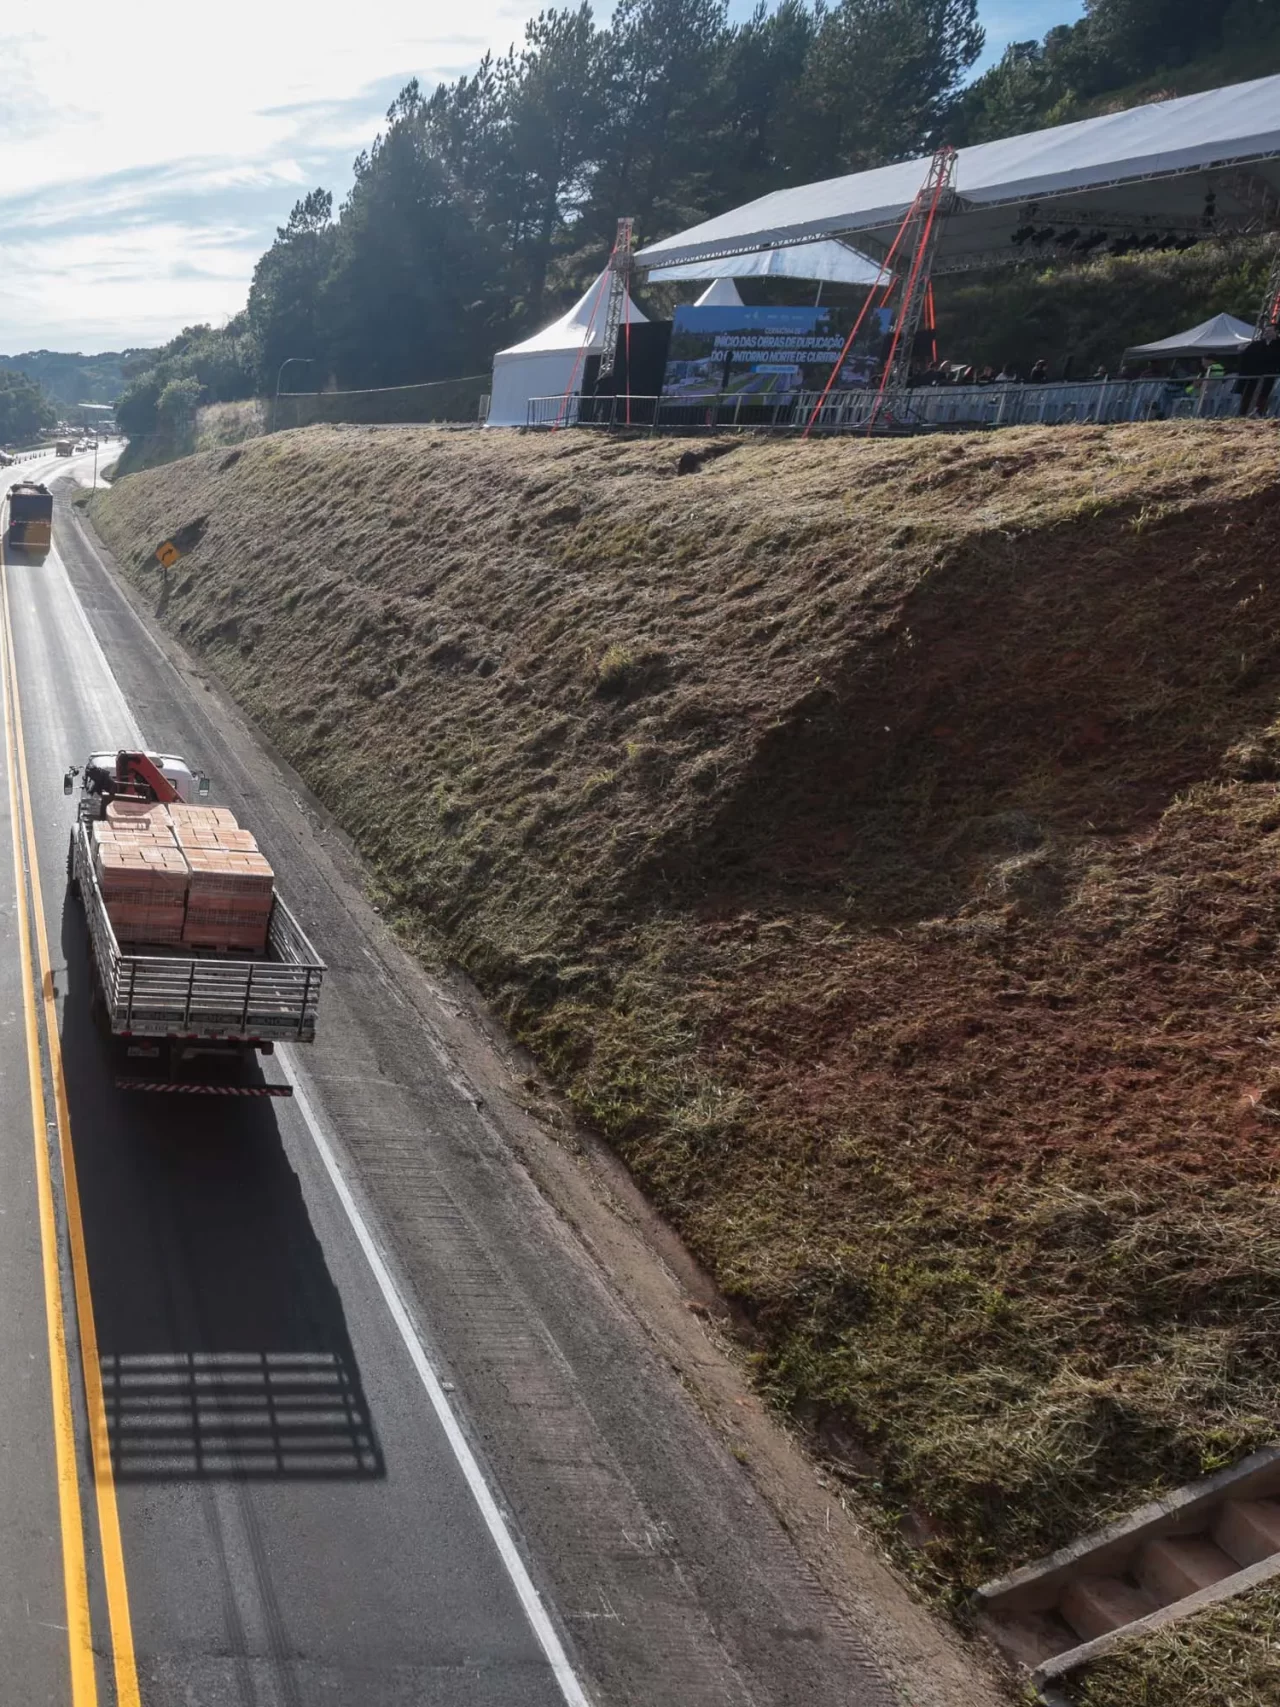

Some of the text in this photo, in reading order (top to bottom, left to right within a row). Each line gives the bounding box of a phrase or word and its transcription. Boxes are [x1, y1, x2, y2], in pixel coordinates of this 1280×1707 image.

[739, 335, 757, 348] DAS
[757, 335, 786, 348] OBRAS
[785, 336, 797, 348] DE
[796, 333, 845, 351] DUPLICAÇÃO
[711, 350, 723, 362] DO
[769, 351, 796, 363] NORTE
[796, 351, 807, 363] DE
